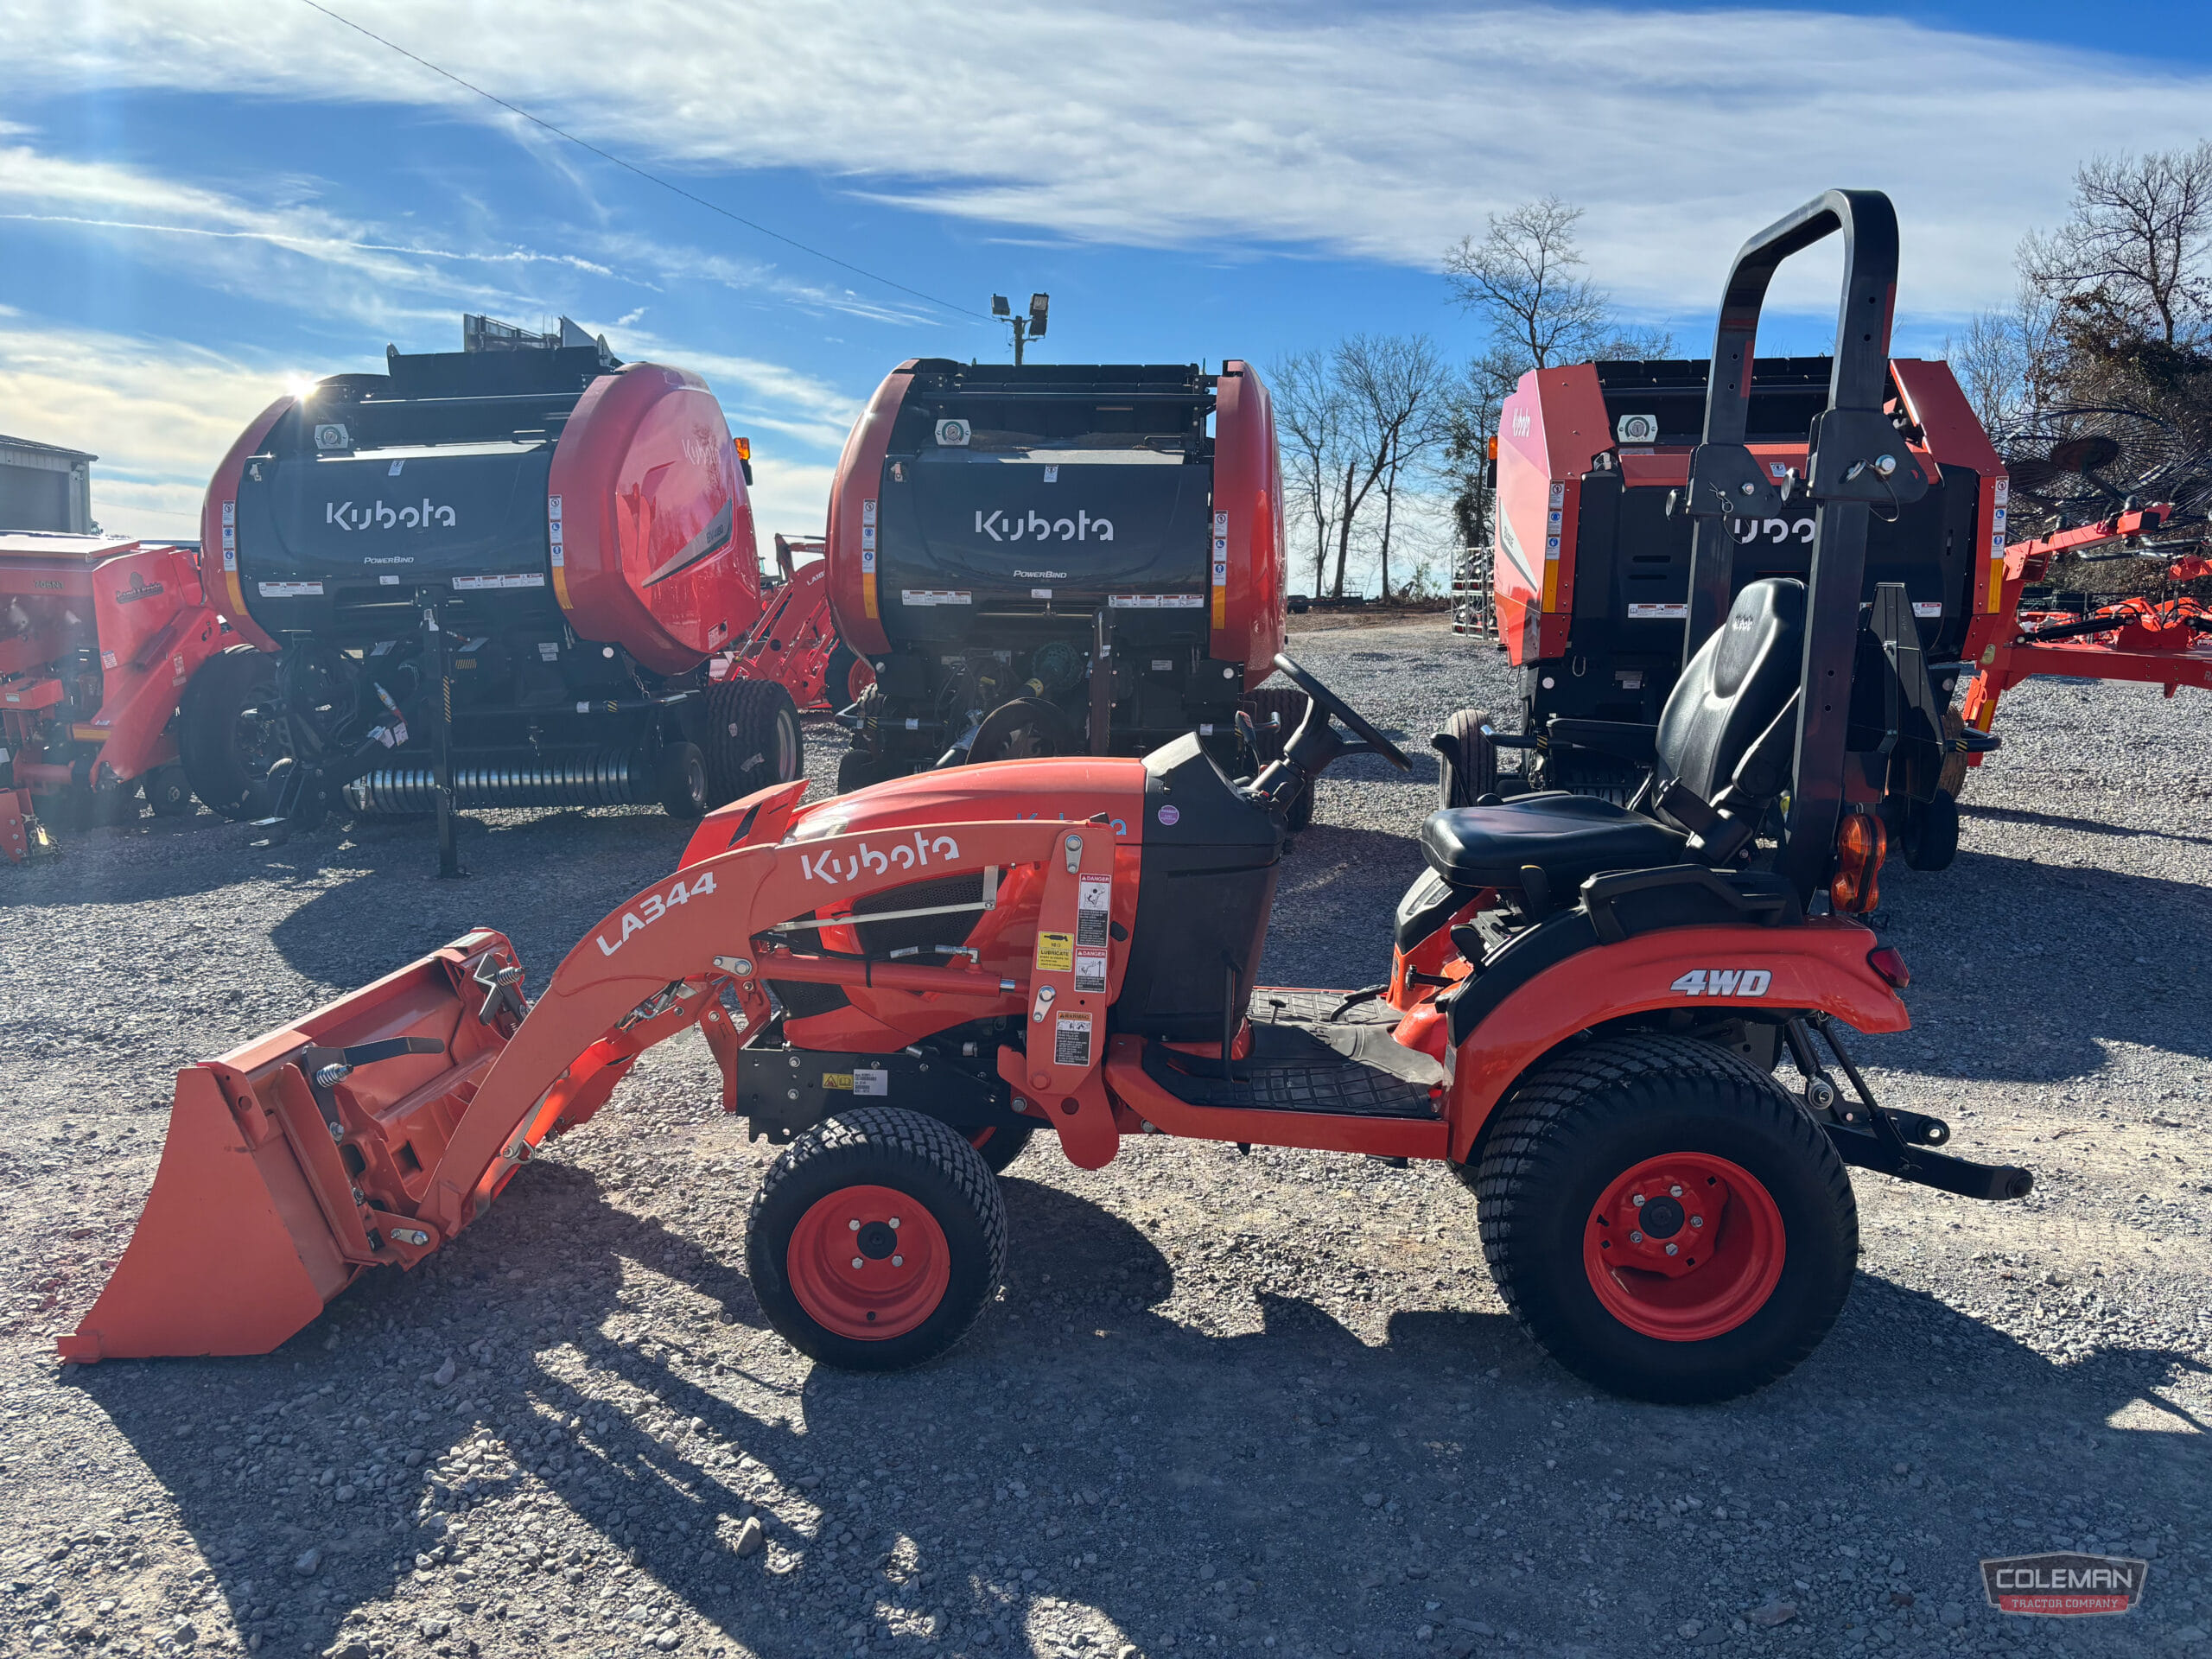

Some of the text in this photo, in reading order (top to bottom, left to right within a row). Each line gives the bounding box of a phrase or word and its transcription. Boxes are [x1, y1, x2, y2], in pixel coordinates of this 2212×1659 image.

[326, 498, 456, 531] Kubota
[975, 510, 1114, 541] Kubota
[801, 831, 960, 885] Kubota
[596, 871, 717, 957] LA344
[1669, 969, 1773, 997] 4WD
